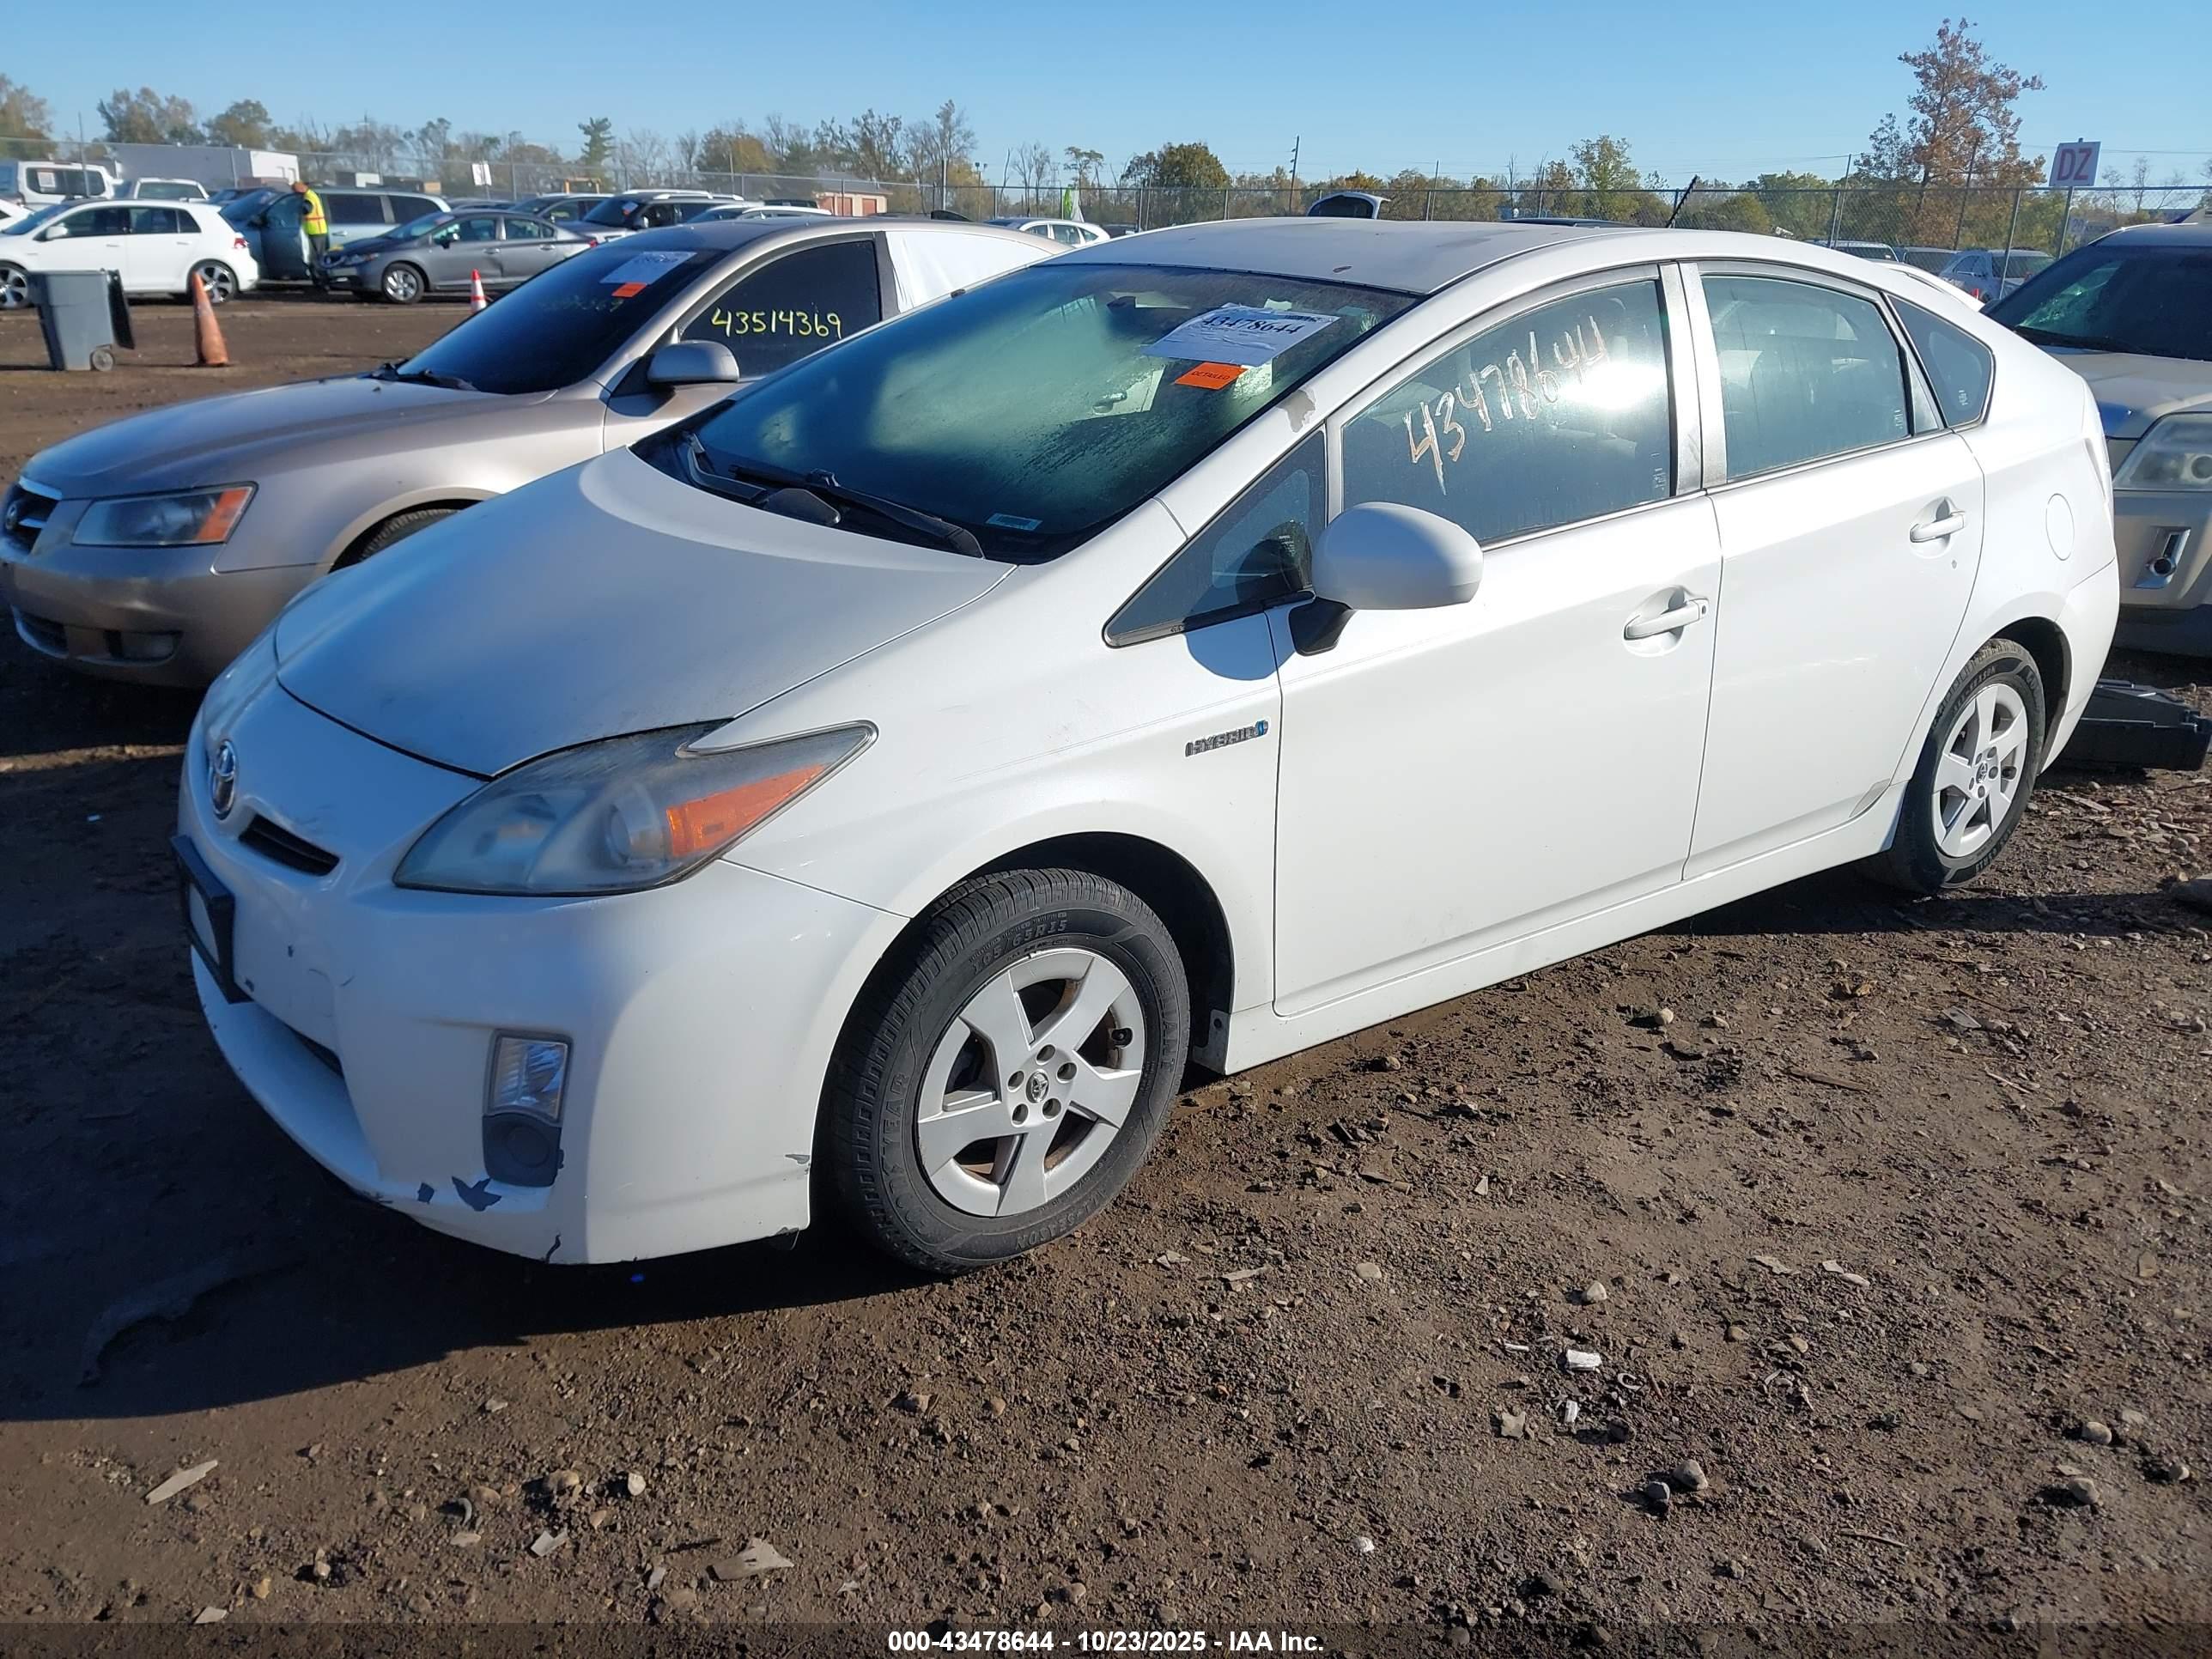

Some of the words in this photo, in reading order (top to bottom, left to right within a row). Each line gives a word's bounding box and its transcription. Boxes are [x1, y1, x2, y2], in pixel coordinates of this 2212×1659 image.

[2057, 147, 2094, 181] DZ
[711, 307, 842, 339] 43514369
[1202, 314, 1304, 335] 43478644
[1190, 370, 1231, 380] DETAILED
[1402, 315, 1611, 495] 43478644
[1185, 726, 1255, 757] HYBRID
